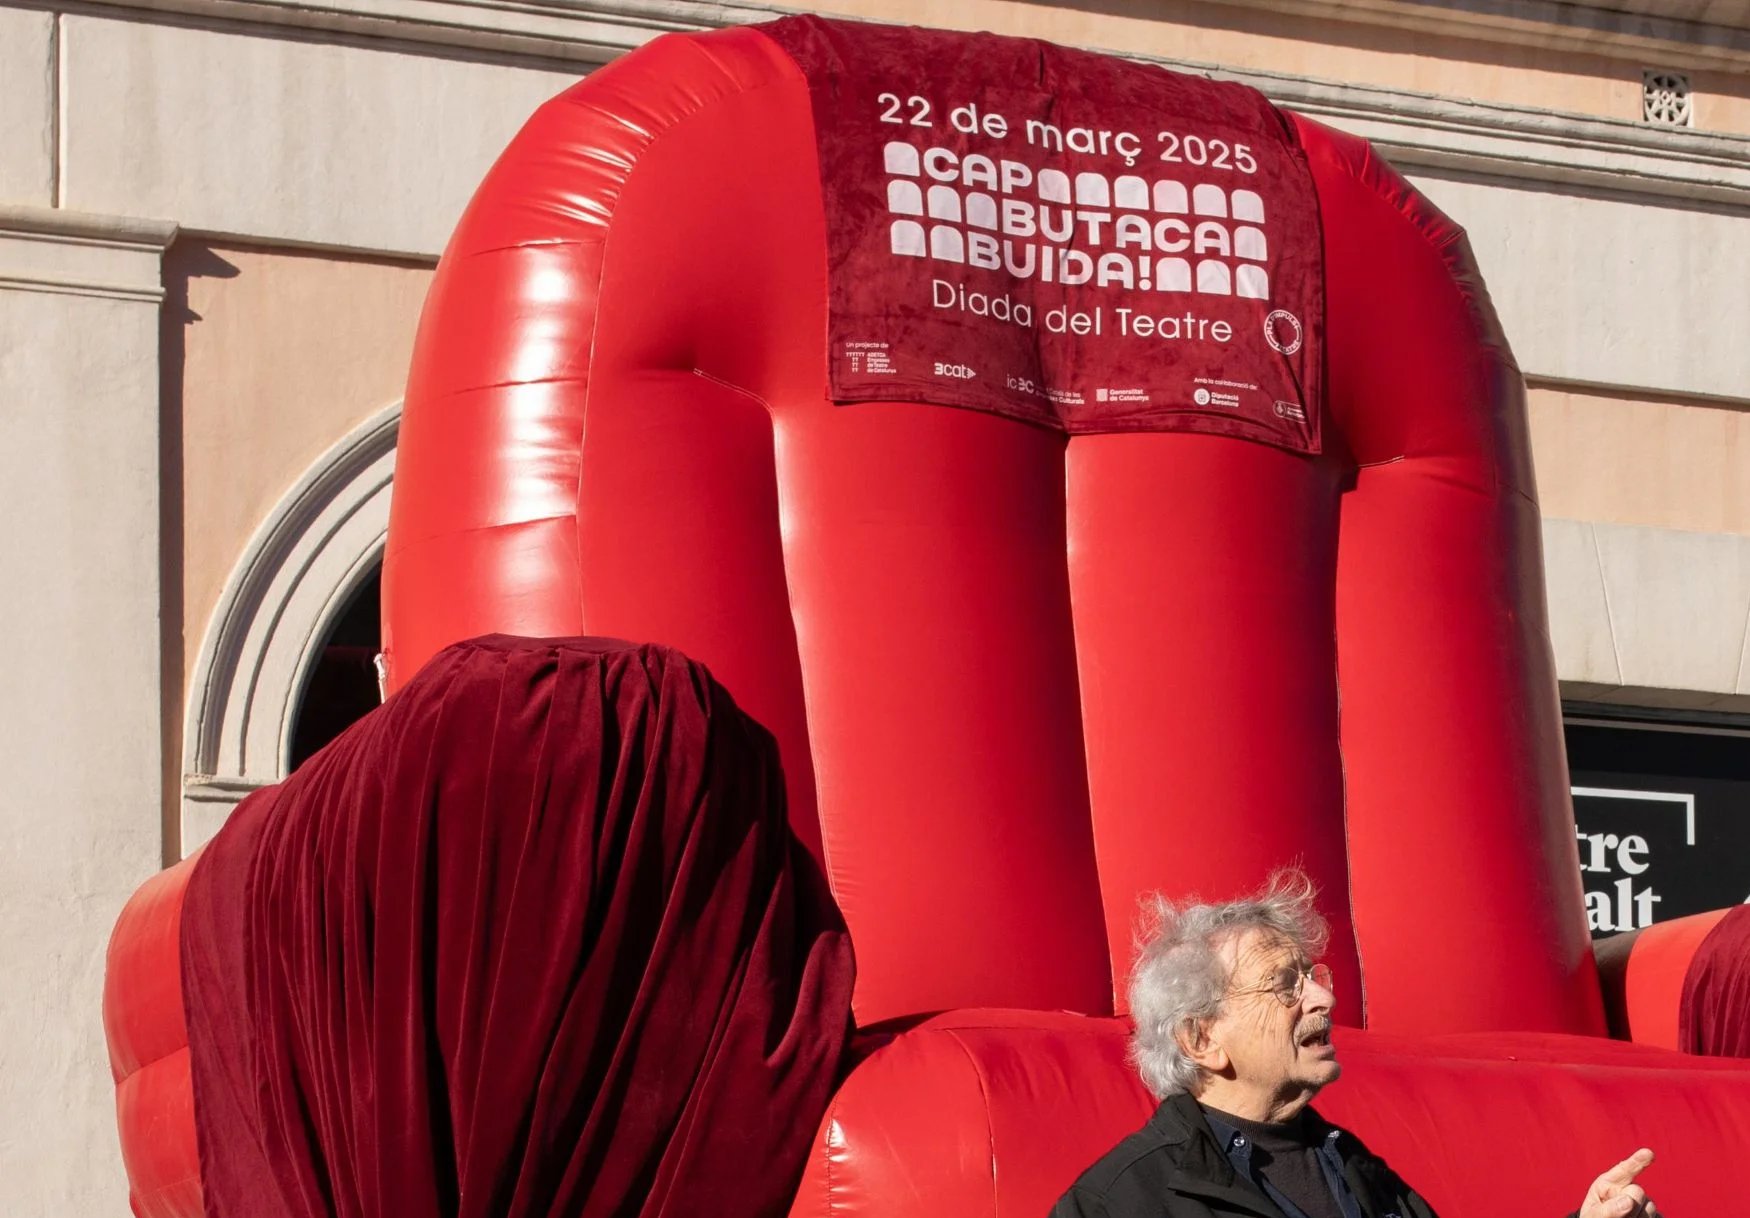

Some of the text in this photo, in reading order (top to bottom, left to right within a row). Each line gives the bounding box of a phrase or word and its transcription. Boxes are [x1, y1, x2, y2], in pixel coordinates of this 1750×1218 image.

[877, 92, 1258, 174] 22 de març 2025
[923, 147, 1032, 194] CAP
[1002, 199, 1231, 257] BUTACA
[967, 231, 1151, 291] BUIDA!
[932, 280, 1233, 343] Diada del Teatre
[934, 362, 968, 379] 3cat
